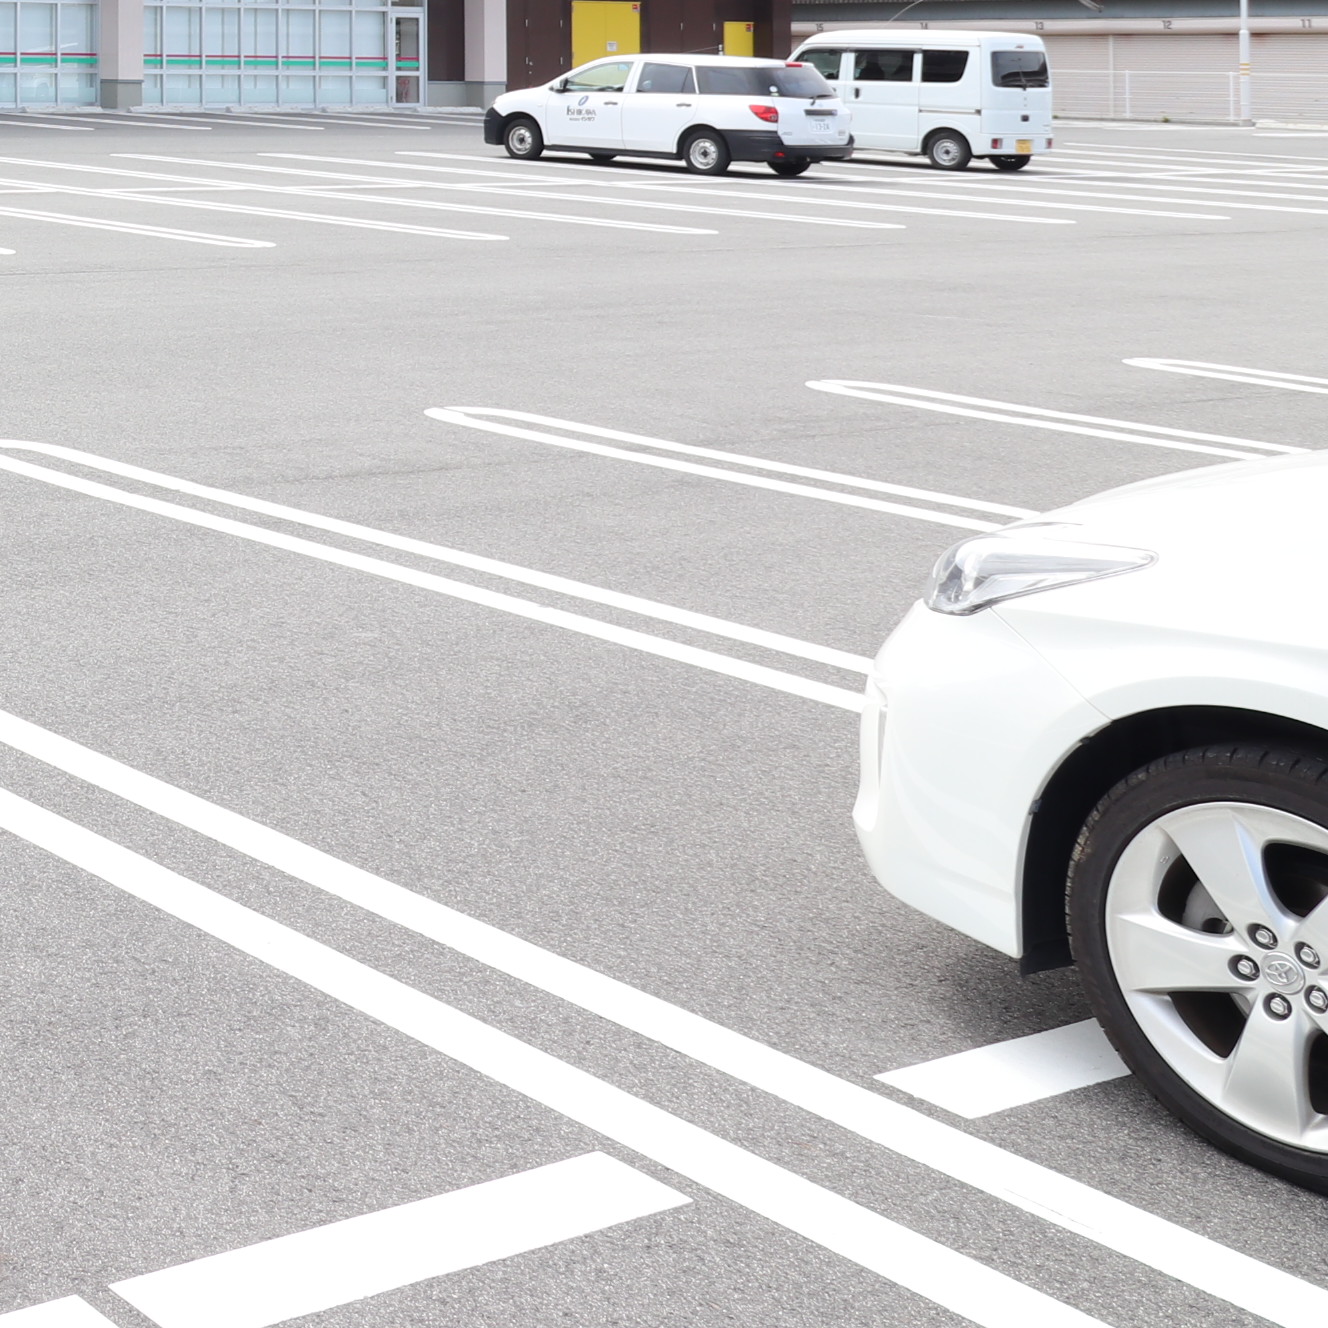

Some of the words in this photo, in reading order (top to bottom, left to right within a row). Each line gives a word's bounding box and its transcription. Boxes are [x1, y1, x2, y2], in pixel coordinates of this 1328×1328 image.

[1034, 21, 1044, 30] 13
[1162, 20, 1172, 29] 12
[1301, 19, 1312, 28] 11
